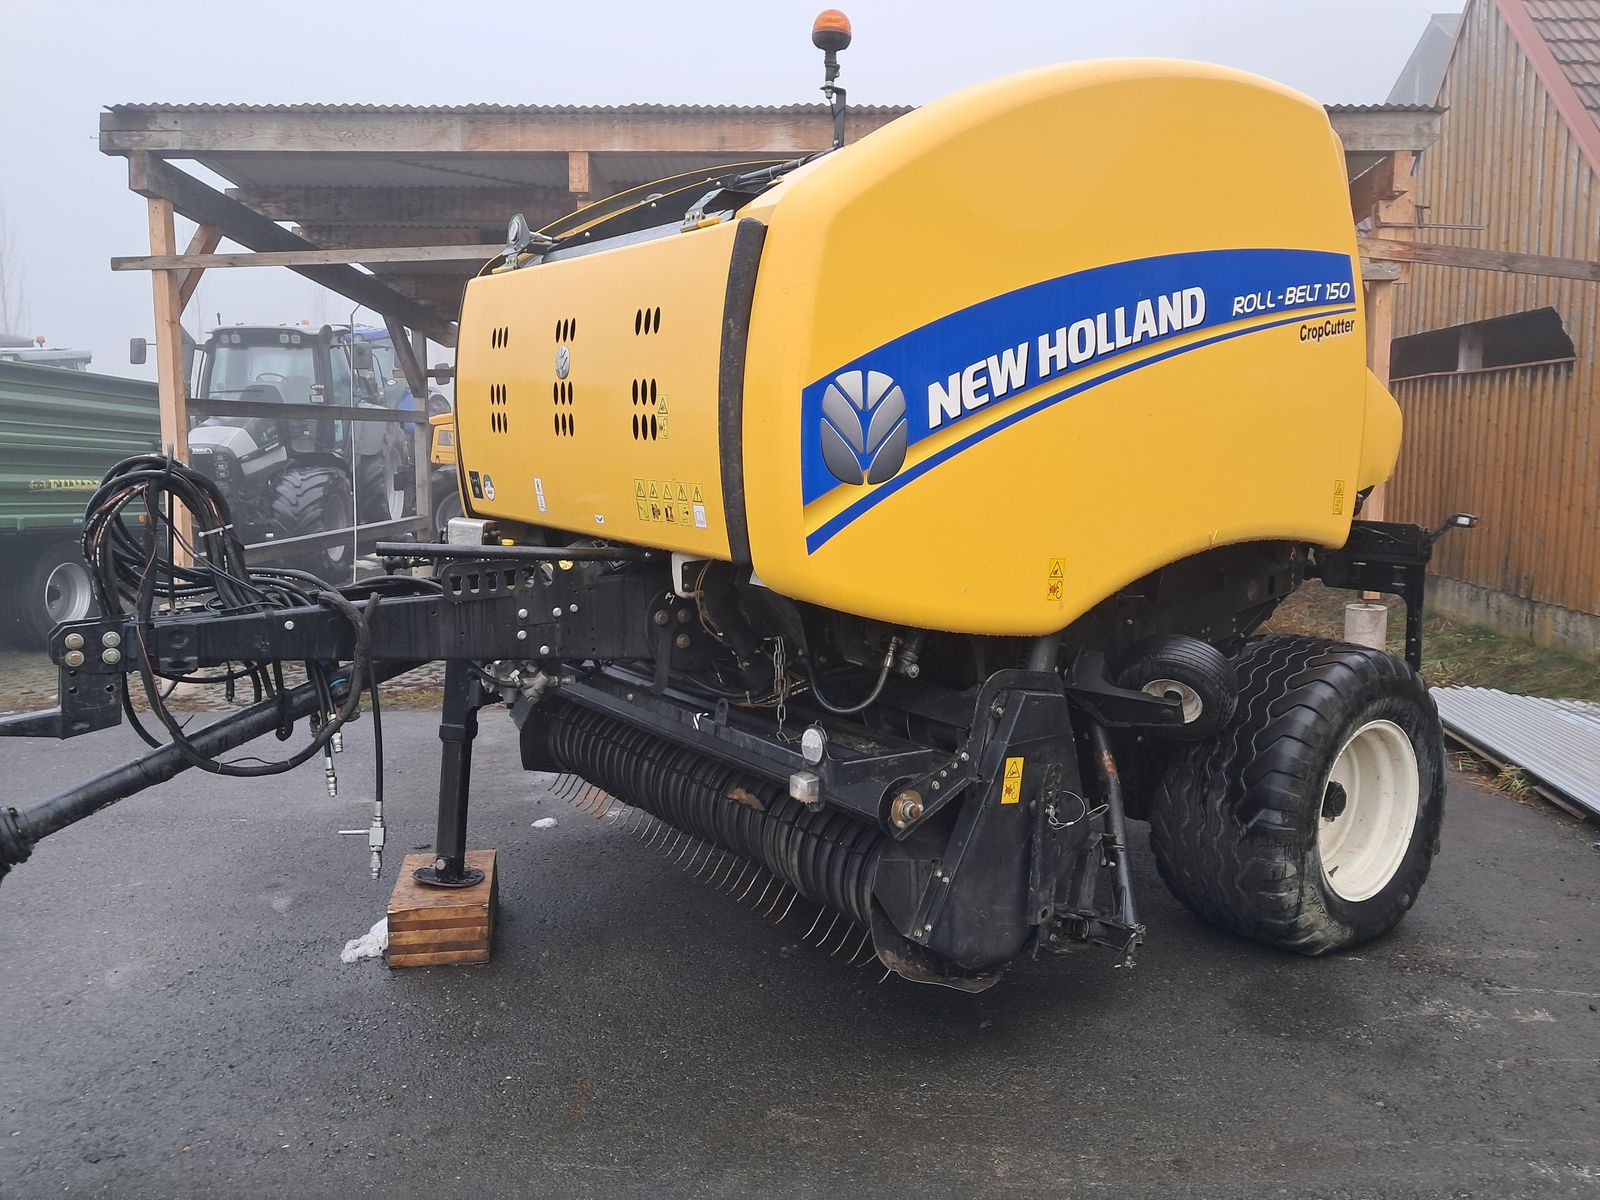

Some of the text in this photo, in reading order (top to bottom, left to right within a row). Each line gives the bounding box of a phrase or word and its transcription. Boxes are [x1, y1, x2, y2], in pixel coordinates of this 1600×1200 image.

[1325, 282, 1351, 300] 150
[1300, 319, 1355, 342] CropCutter
[928, 286, 1207, 430] NEW HOLLAND
